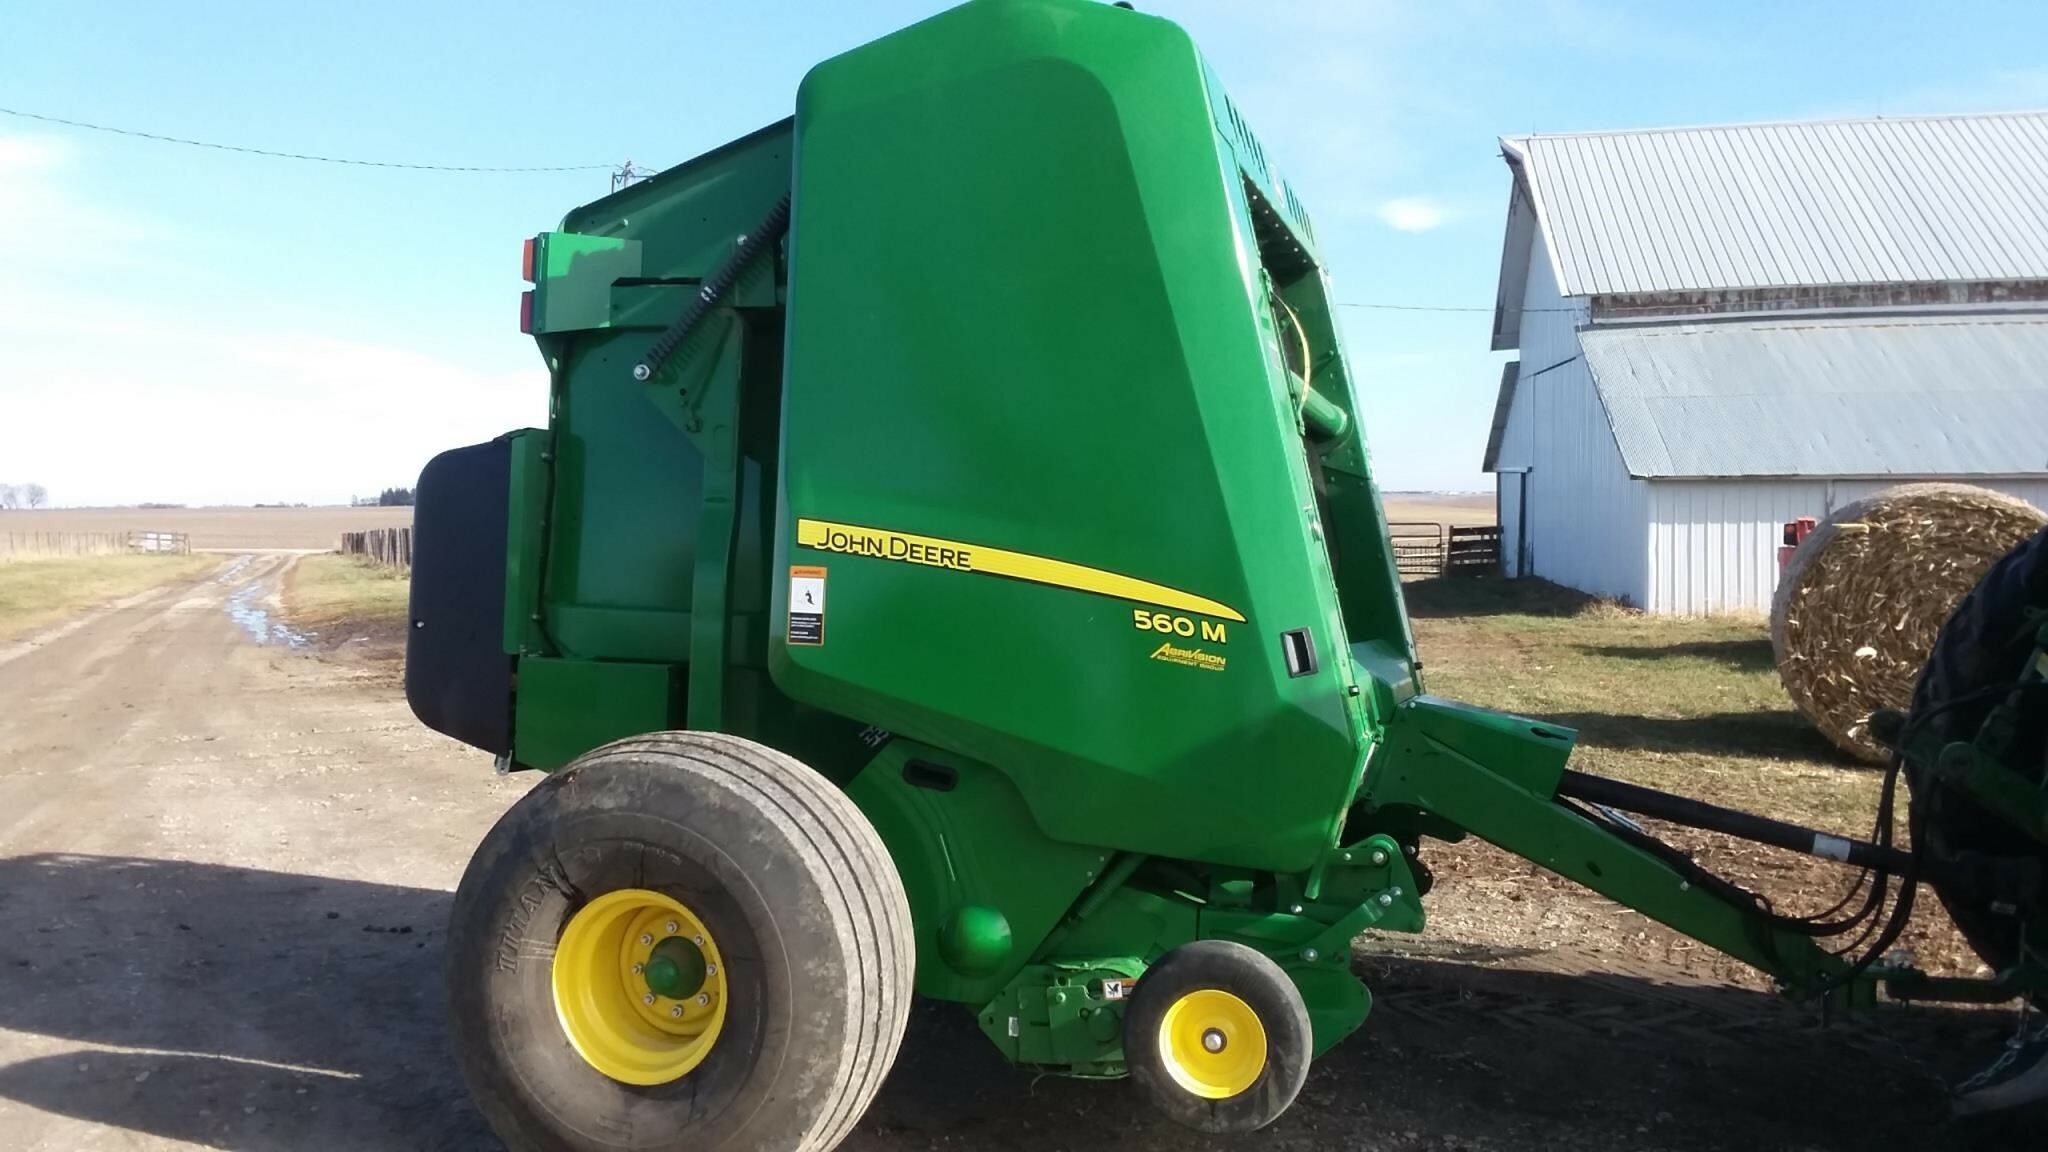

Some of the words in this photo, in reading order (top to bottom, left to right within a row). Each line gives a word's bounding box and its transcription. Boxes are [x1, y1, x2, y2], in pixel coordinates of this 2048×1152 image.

[888, 537, 972, 568] DEERE
[1133, 609, 1195, 637] 560
[1201, 620, 1227, 644] M
